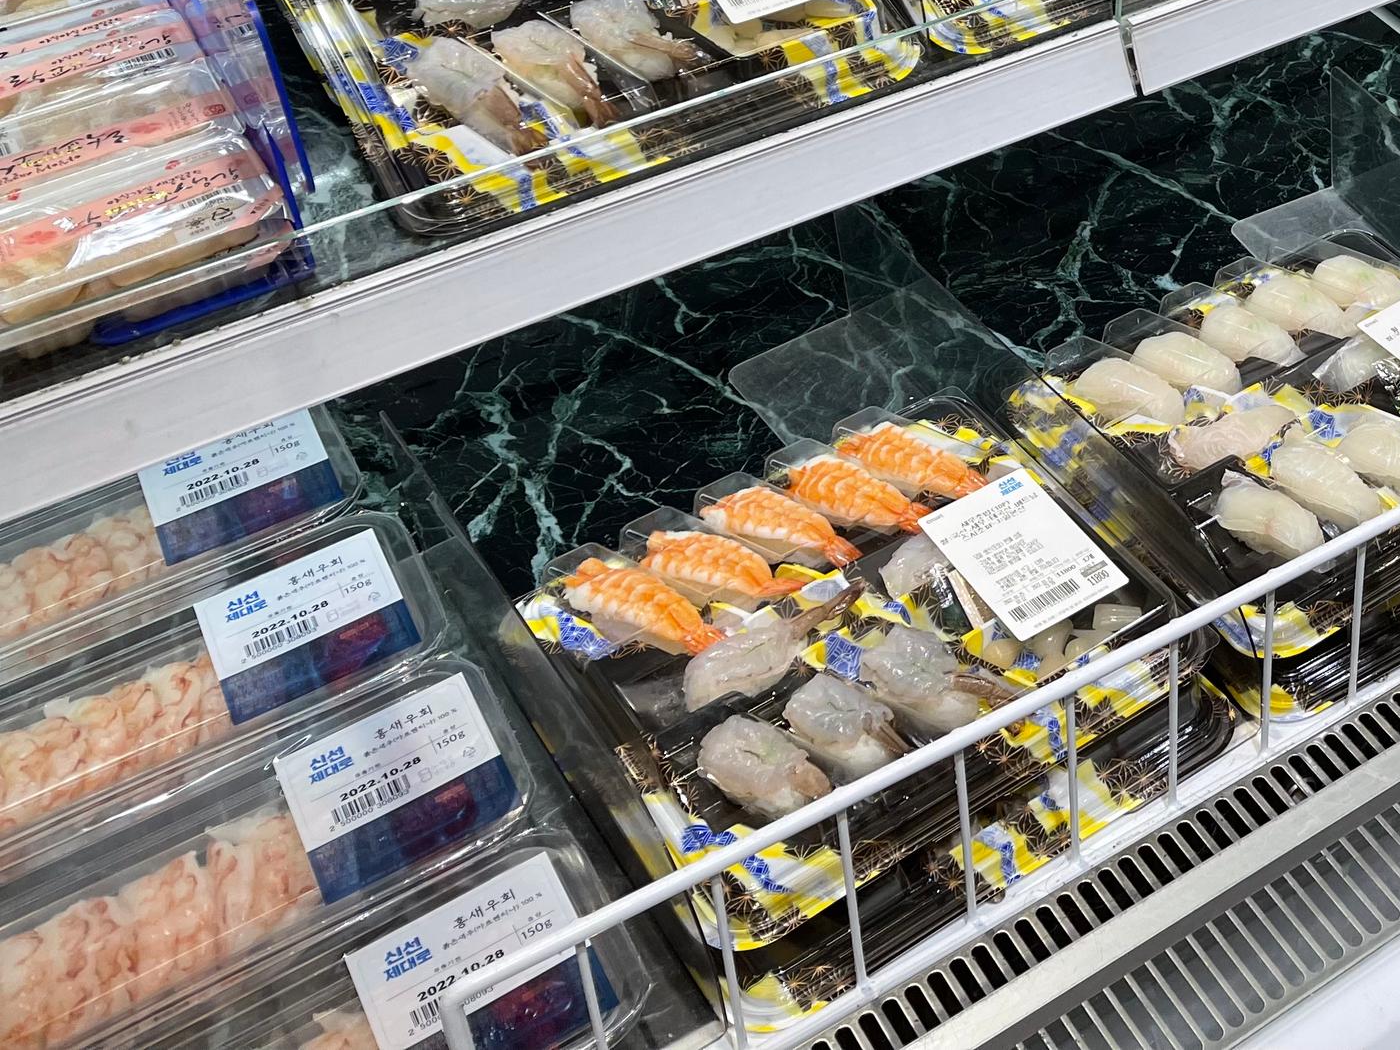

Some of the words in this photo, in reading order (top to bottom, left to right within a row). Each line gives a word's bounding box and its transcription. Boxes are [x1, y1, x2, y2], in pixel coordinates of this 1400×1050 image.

[163, 455, 203, 476] 제대로
[186, 458, 260, 491] 2022.10.28
[288, 556, 343, 586] 홍새우회
[343, 578, 373, 594] 150g
[224, 602, 269, 624] 제대로
[226, 590, 261, 612] 신선
[251, 600, 329, 639] 2022.10.28
[374, 704, 433, 741] 홍새우회
[436, 730, 466, 750] 150g
[309, 745, 345, 771] 신선
[308, 759, 354, 785] 제대로
[339, 756, 422, 802] 2022.10.28
[329, 824, 336, 832] 2
[340, 807, 375, 827] 500000
[453, 888, 516, 929] 홍새우회
[521, 919, 553, 940] 150g
[384, 936, 423, 965] 신선
[383, 949, 433, 982] 제대로
[417, 949, 505, 1002] 2022.10.28
[460, 986, 494, 1008] 08093
